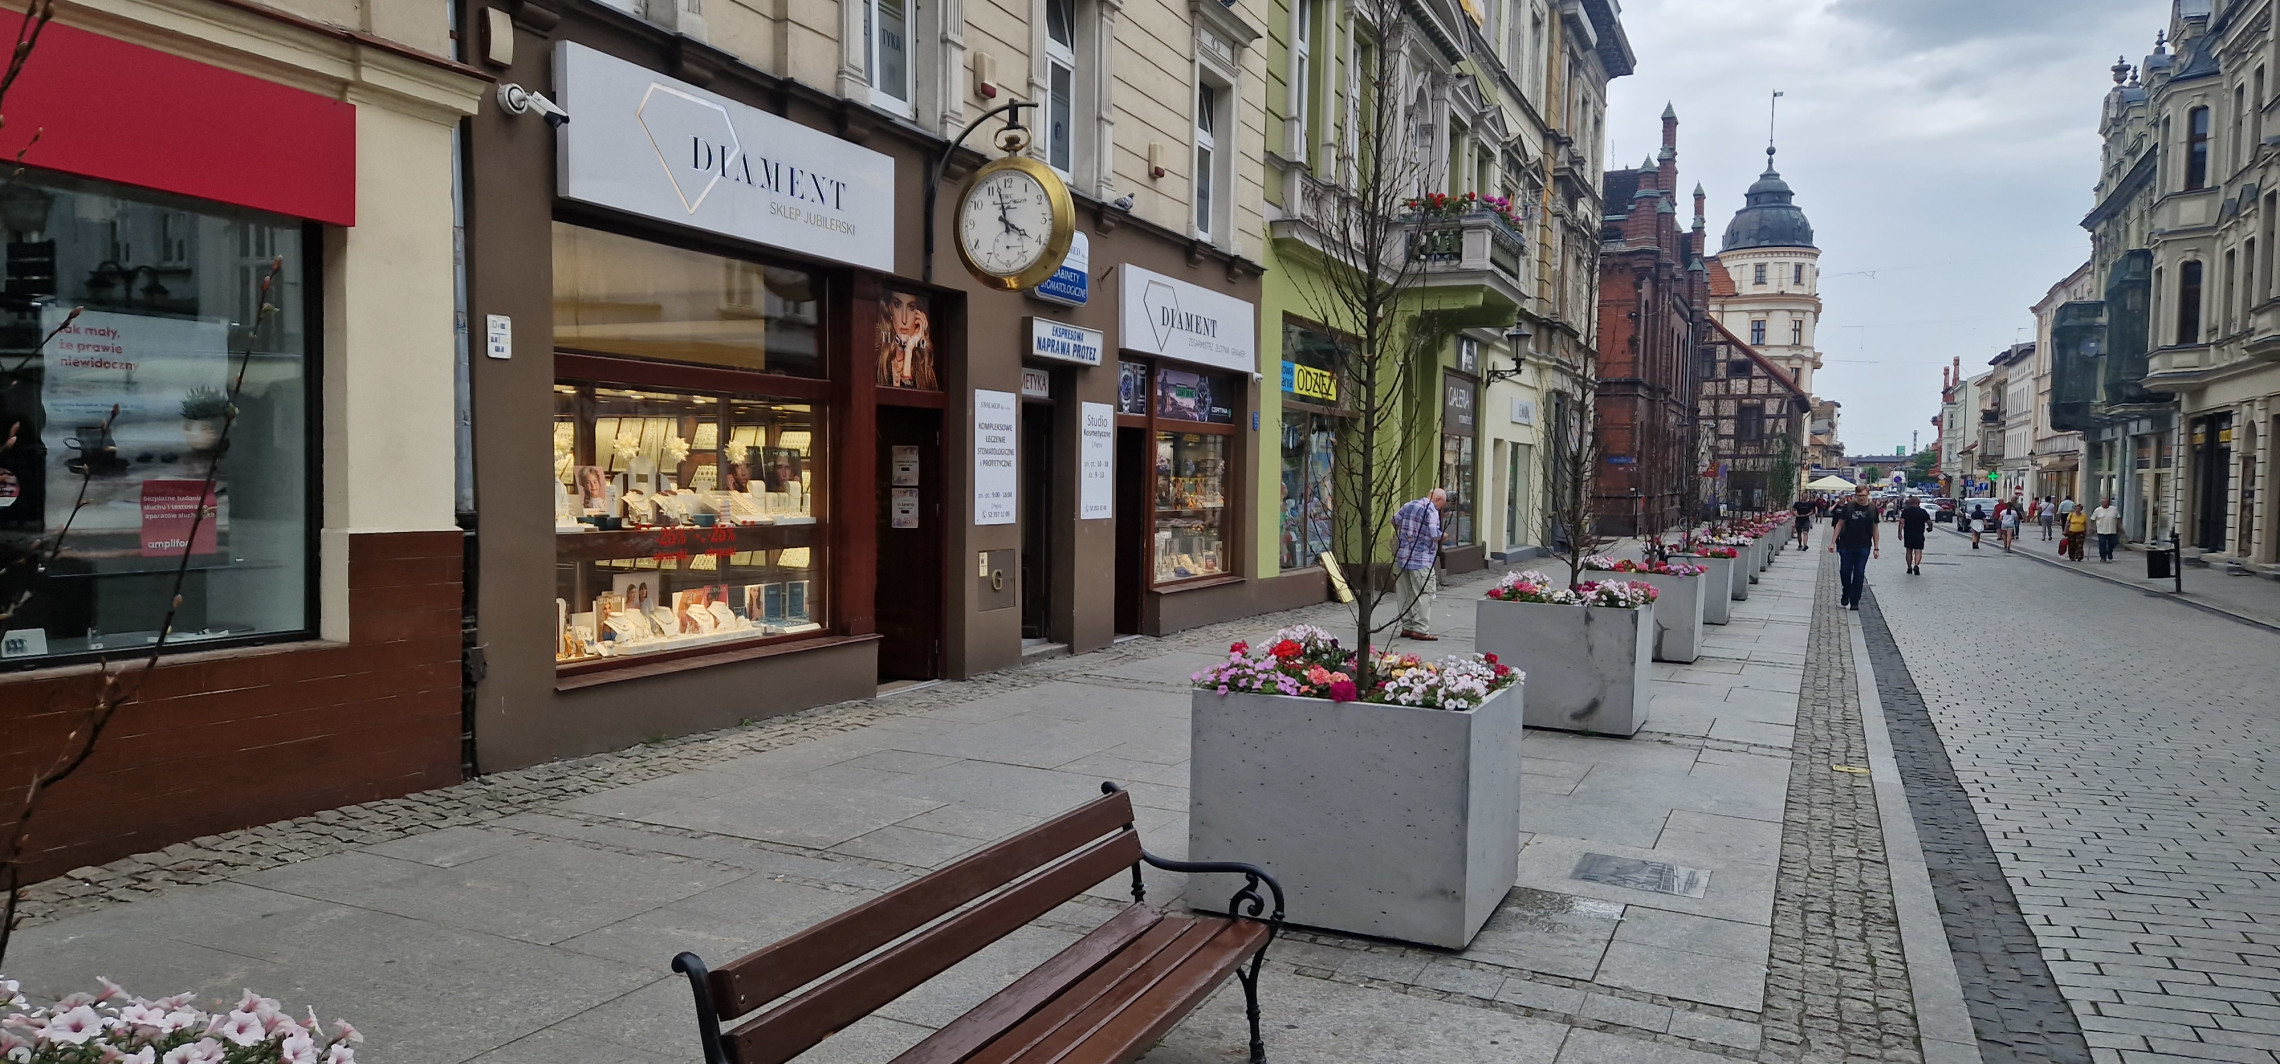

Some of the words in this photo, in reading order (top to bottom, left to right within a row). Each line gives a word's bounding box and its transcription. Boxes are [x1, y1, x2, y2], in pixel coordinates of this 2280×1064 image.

[689, 134, 847, 212] DIAMENT
[1004, 178, 1013, 189] 12
[987, 186, 994, 196] 11
[973, 199, 984, 210] 10
[1036, 194, 1043, 205] 2
[770, 201, 802, 221] SKLEP
[804, 212, 856, 236] JUBILERSKI
[1040, 213, 1048, 225] 3
[968, 220, 976, 230] 9
[974, 238, 980, 250] 8
[1035, 234, 1042, 246] 4
[986, 252, 993, 264] 7
[1161, 306, 1218, 338] DIAMENT
[1052, 326, 1084, 344] EKSPRESOWA
[60, 339, 74, 350] że
[77, 342, 123, 354] prawie
[1036, 336, 1070, 356] NAPRAWA
[1072, 342, 1097, 362] PROTEZ
[60, 356, 139, 372] niewidoczny
[1087, 414, 1108, 427] Studio
[978, 422, 1012, 432] KOMPLEKSOWE
[1084, 428, 1112, 438] Kosmetyczne
[986, 435, 1006, 444] LECZENIE
[992, 568, 1004, 591] G
